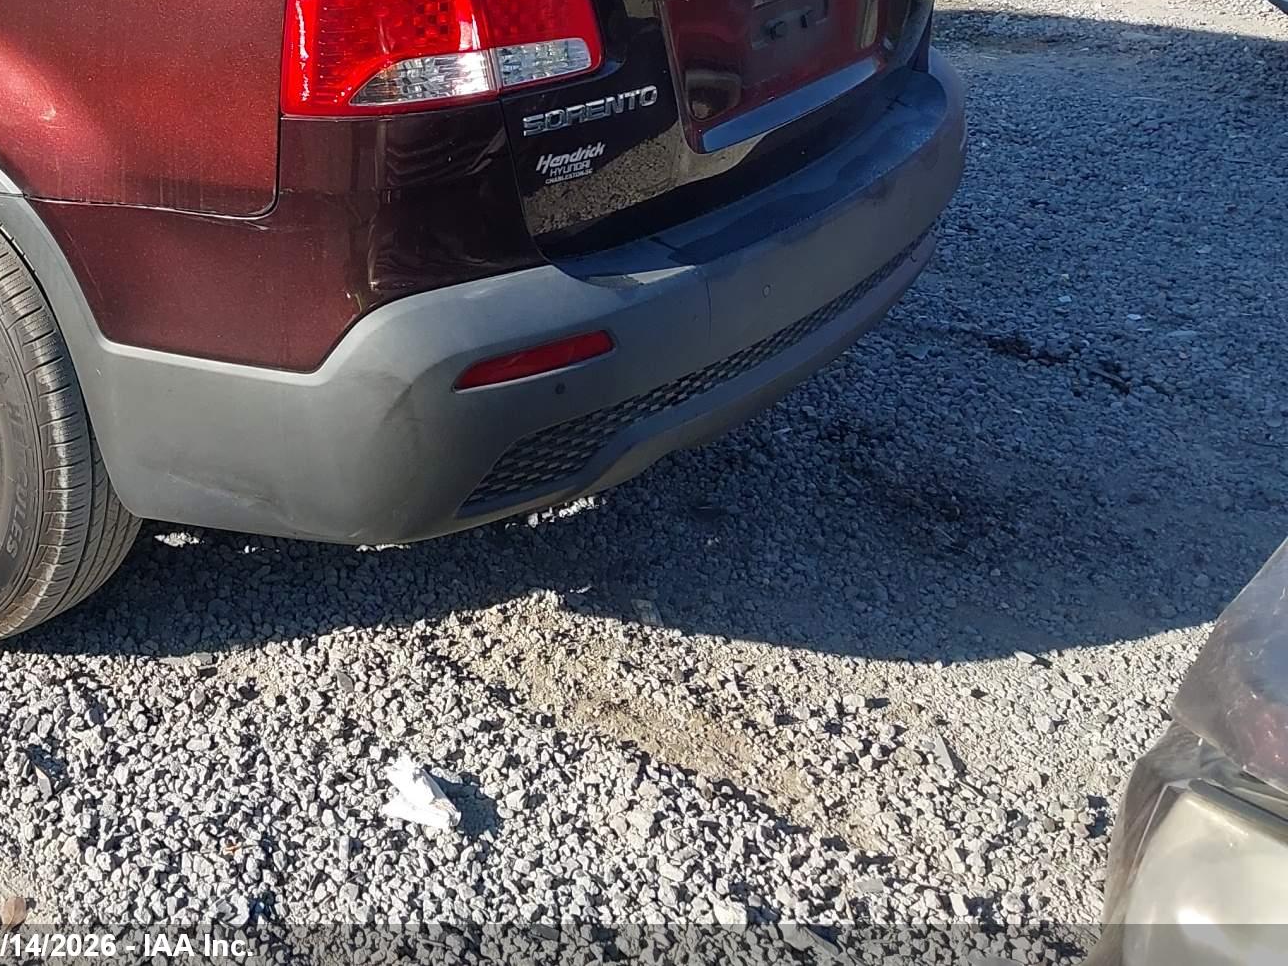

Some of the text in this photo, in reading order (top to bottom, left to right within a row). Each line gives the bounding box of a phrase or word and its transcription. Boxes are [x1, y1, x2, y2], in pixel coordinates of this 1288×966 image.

[523, 85, 658, 136] SORENTO
[536, 141, 606, 174] Hendrick
[550, 159, 591, 177] HYUNDAI
